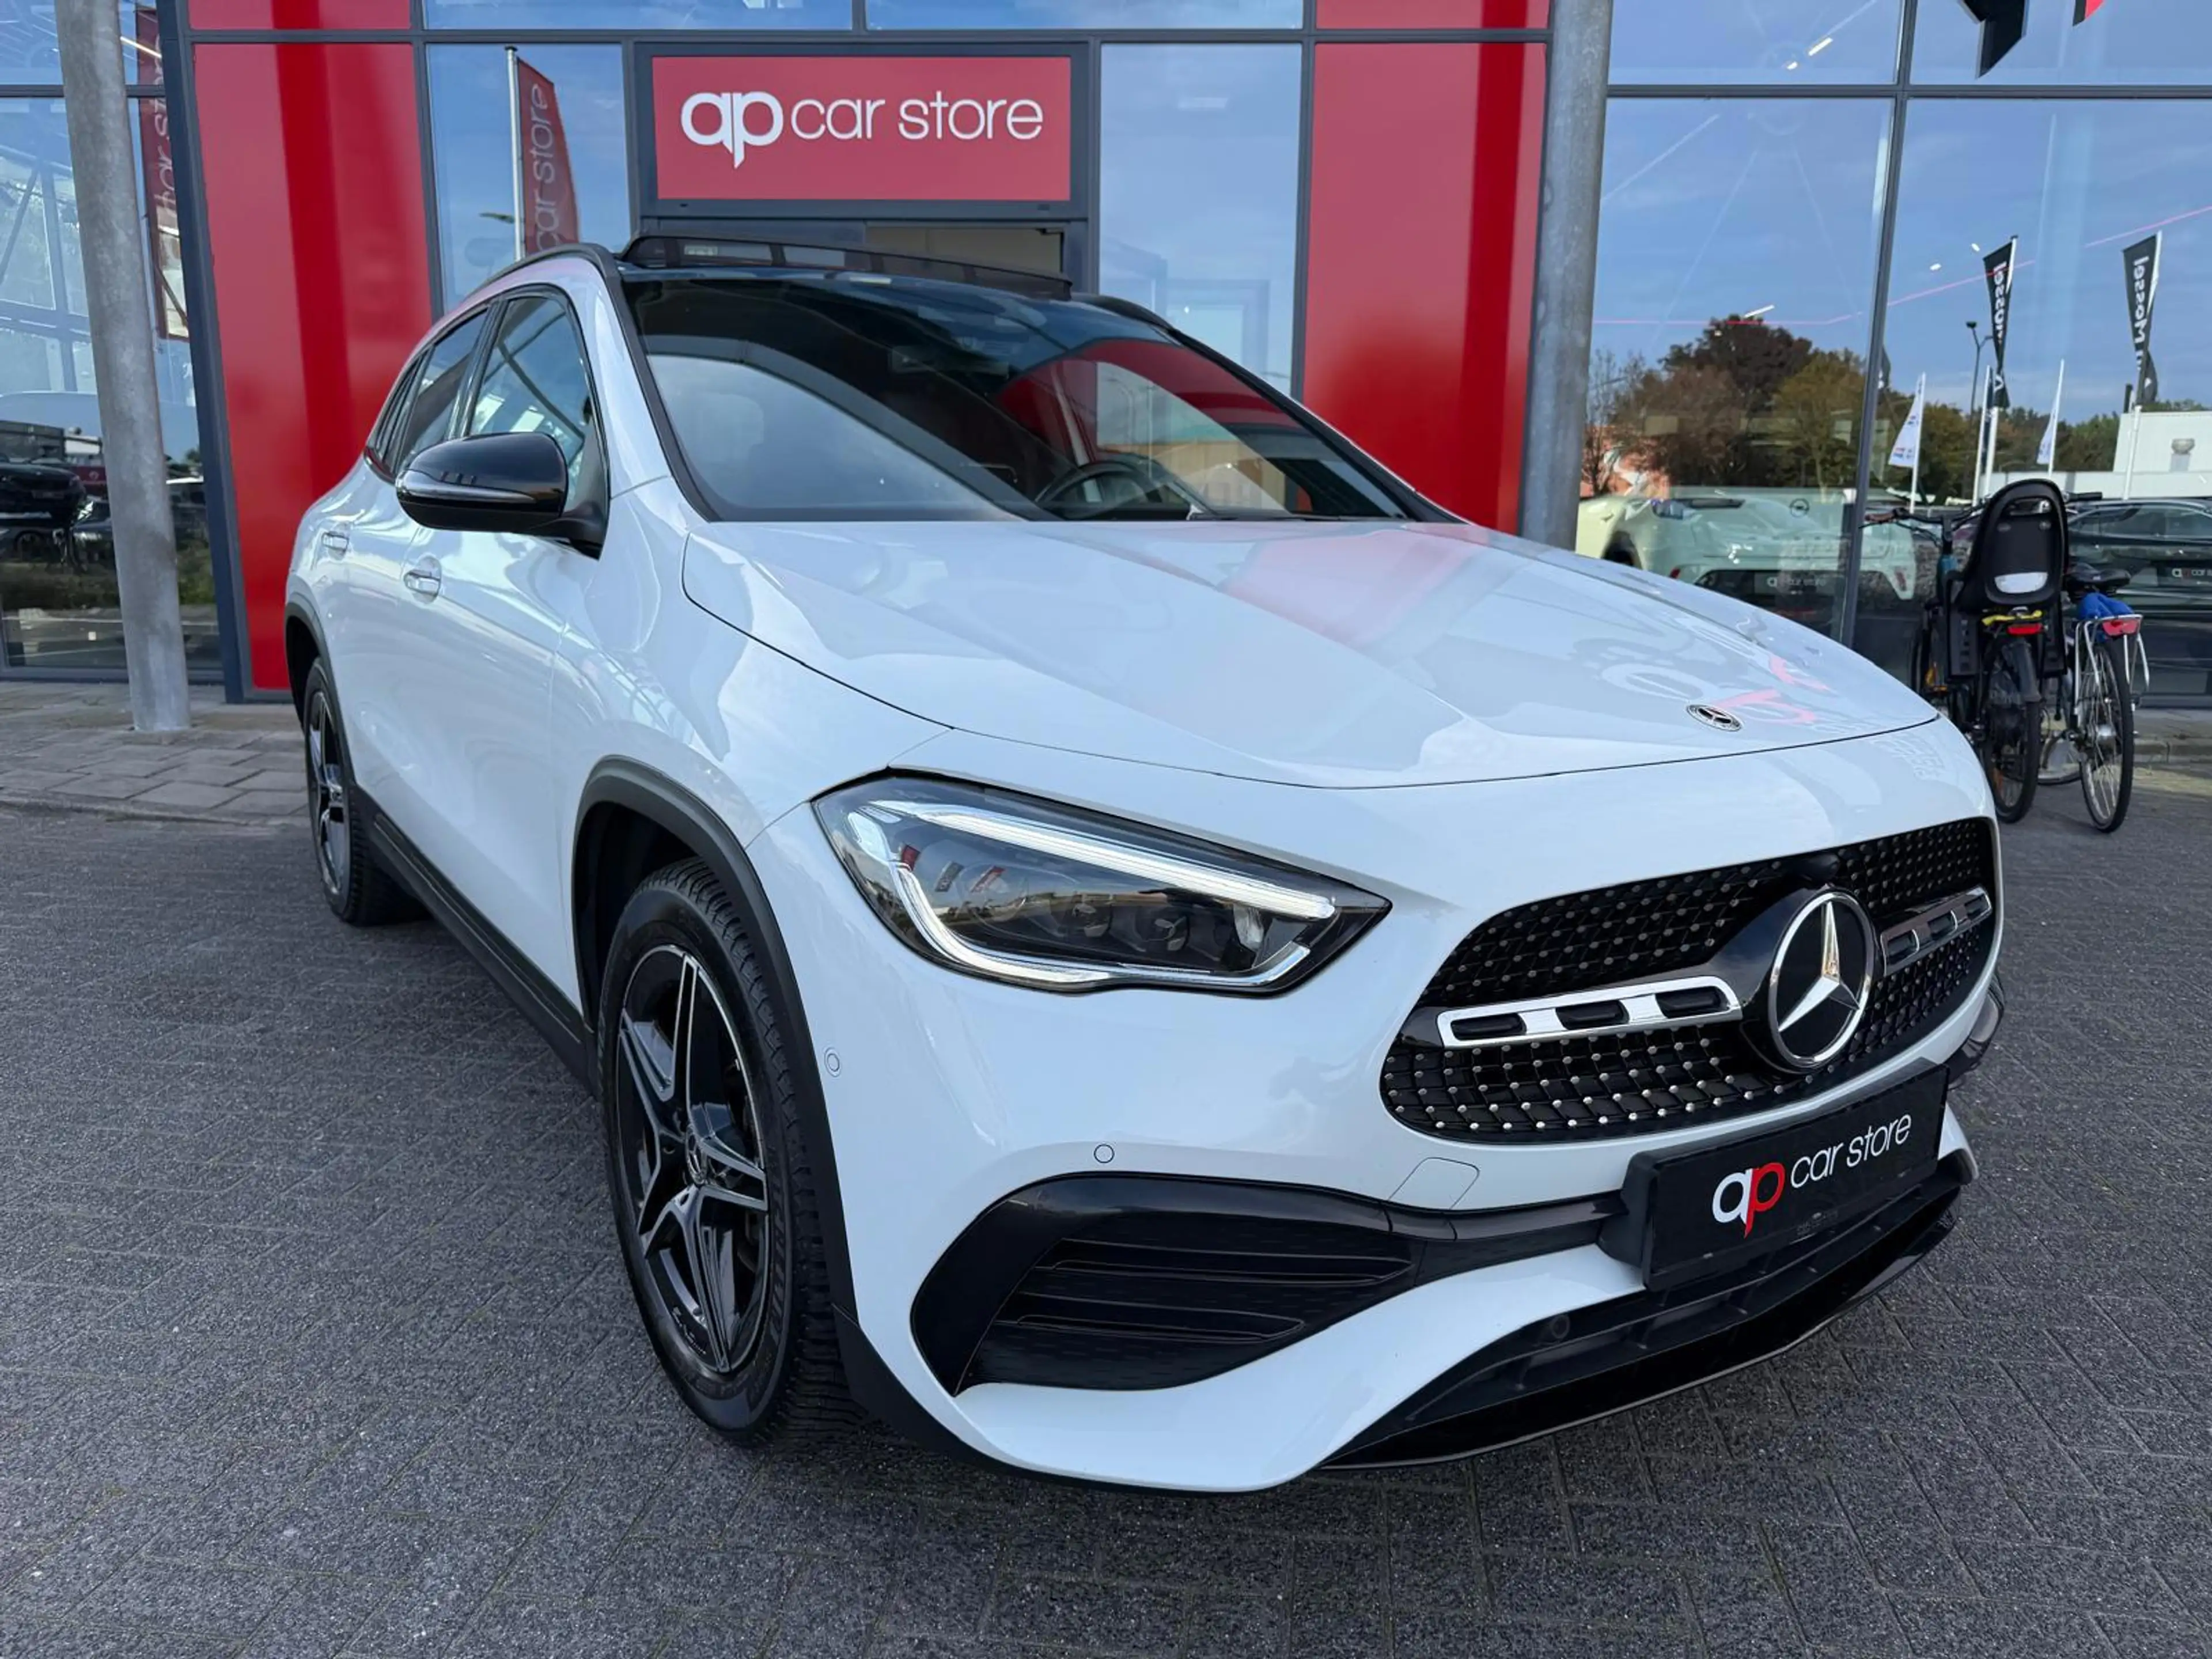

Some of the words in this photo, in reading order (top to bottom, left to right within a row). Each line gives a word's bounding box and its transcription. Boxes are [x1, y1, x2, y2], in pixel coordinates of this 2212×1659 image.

[529, 83, 555, 184] store
[681, 91, 784, 169] ap
[791, 99, 885, 139] car
[898, 90, 1043, 140] store
[534, 189, 559, 252] car
[1712, 1162, 1785, 1239] ap
[1790, 1141, 1844, 1188] car
[1846, 1114, 1912, 1168] store
